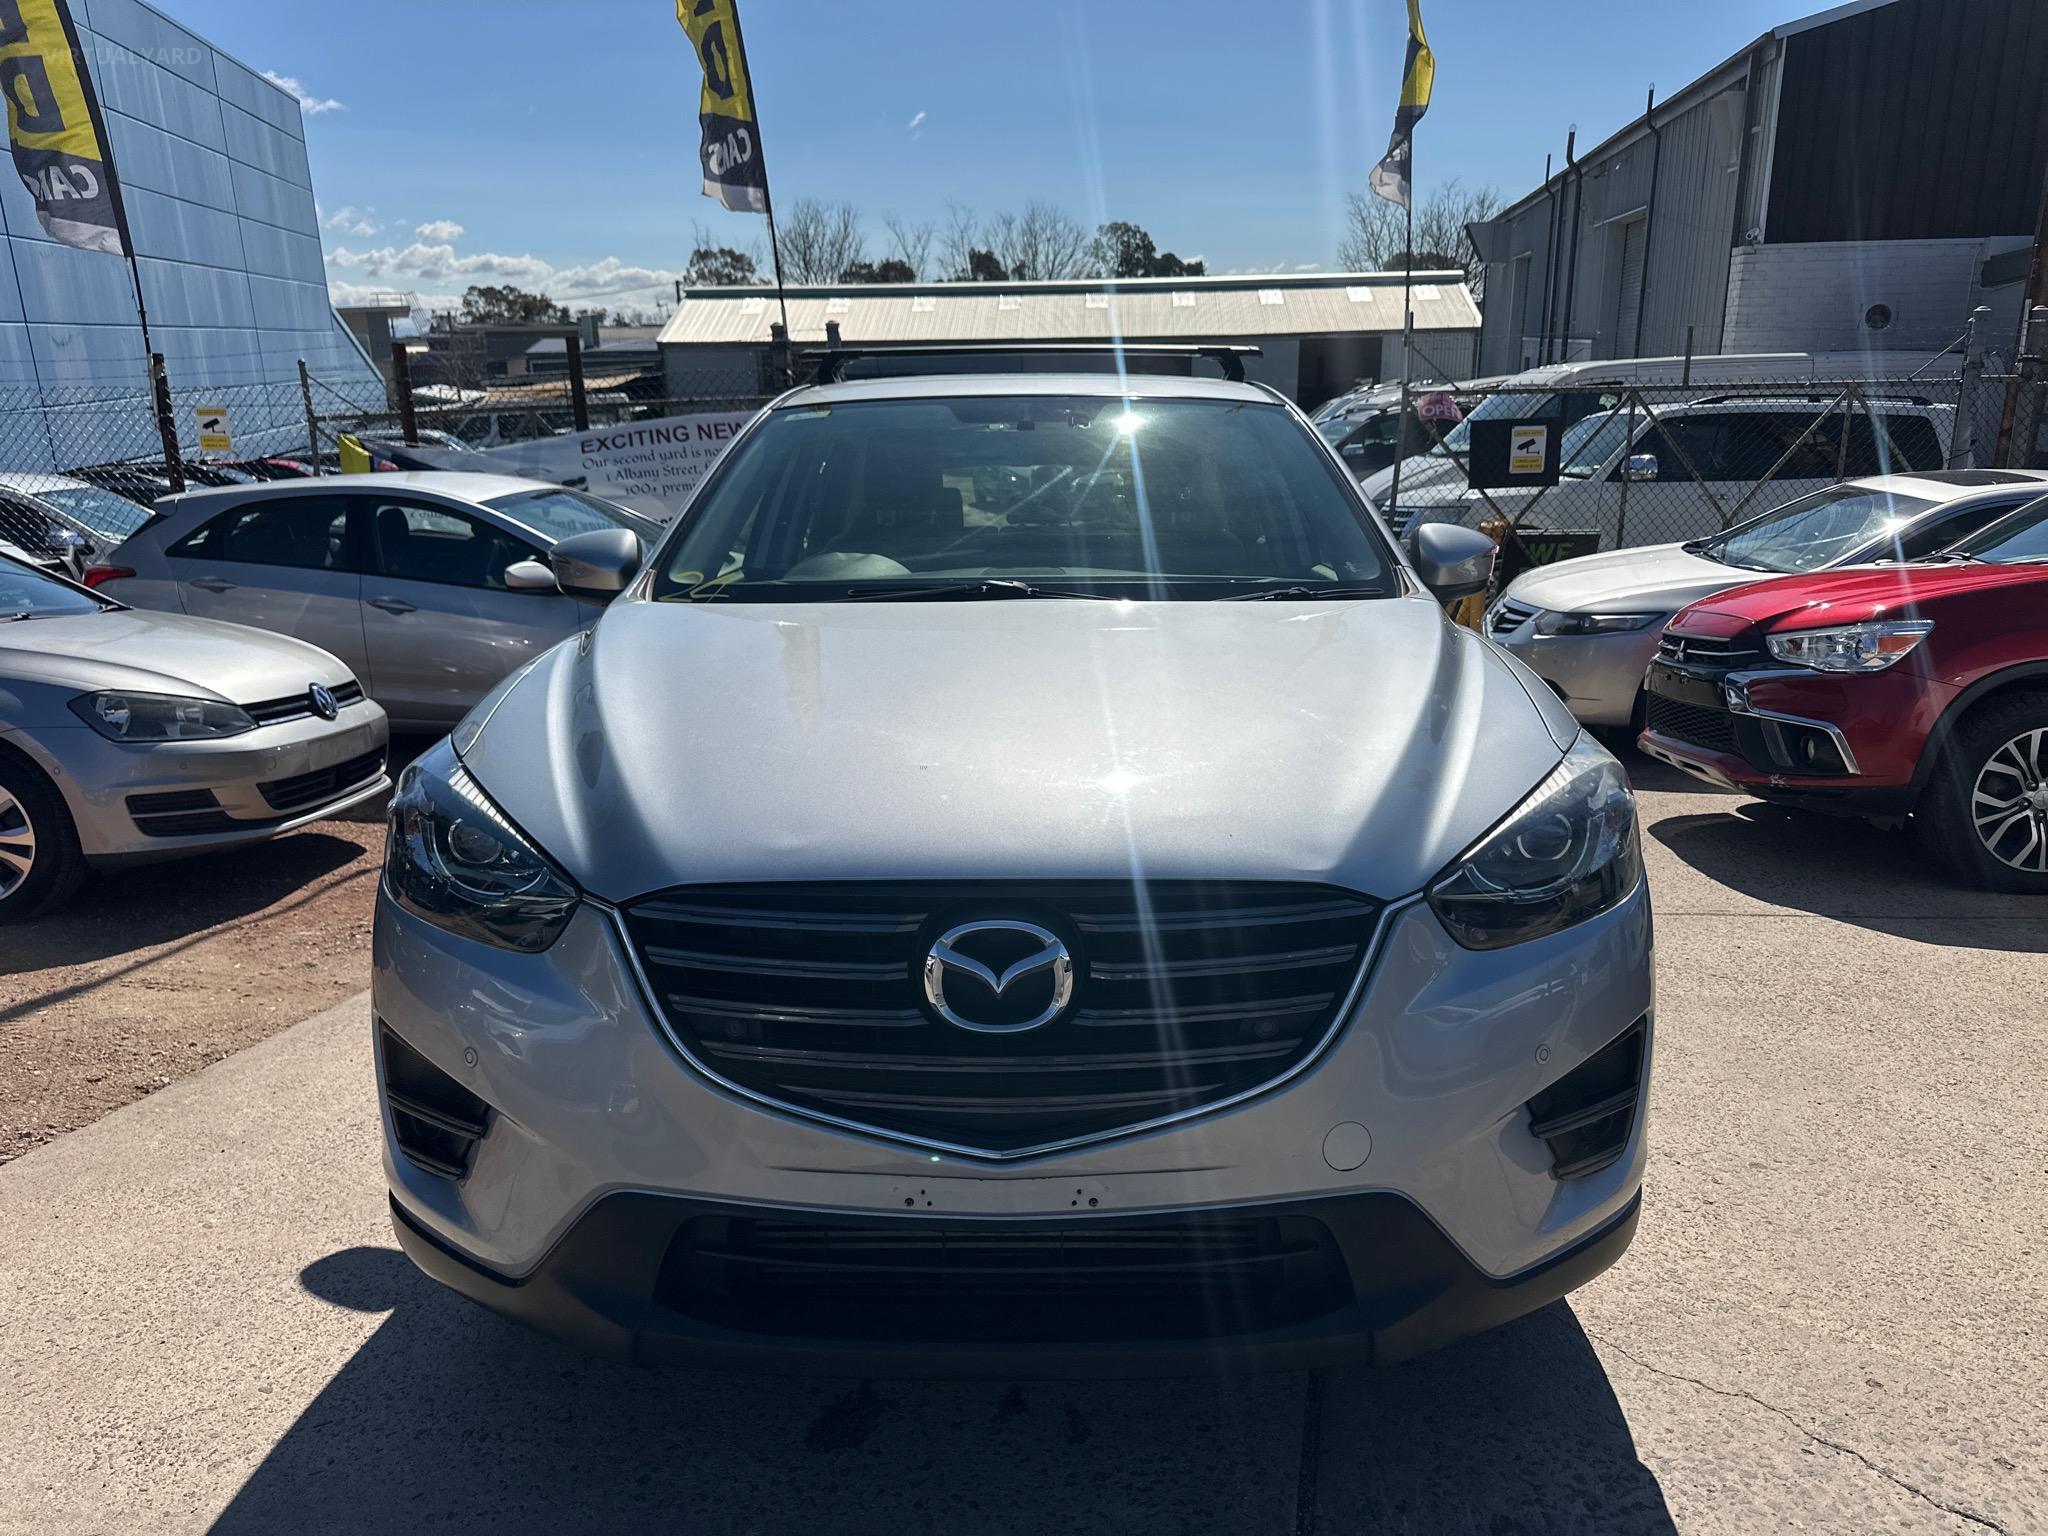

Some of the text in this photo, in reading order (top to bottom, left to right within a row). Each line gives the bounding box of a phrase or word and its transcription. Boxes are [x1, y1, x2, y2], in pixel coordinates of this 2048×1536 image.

[1422, 403, 1463, 421] OPEN
[580, 424, 690, 455] EXCITING
[582, 457, 607, 471] Our
[613, 449, 656, 466] second
[660, 445, 688, 464] yard
[690, 445, 701, 459] is
[617, 467, 660, 482] Albany
